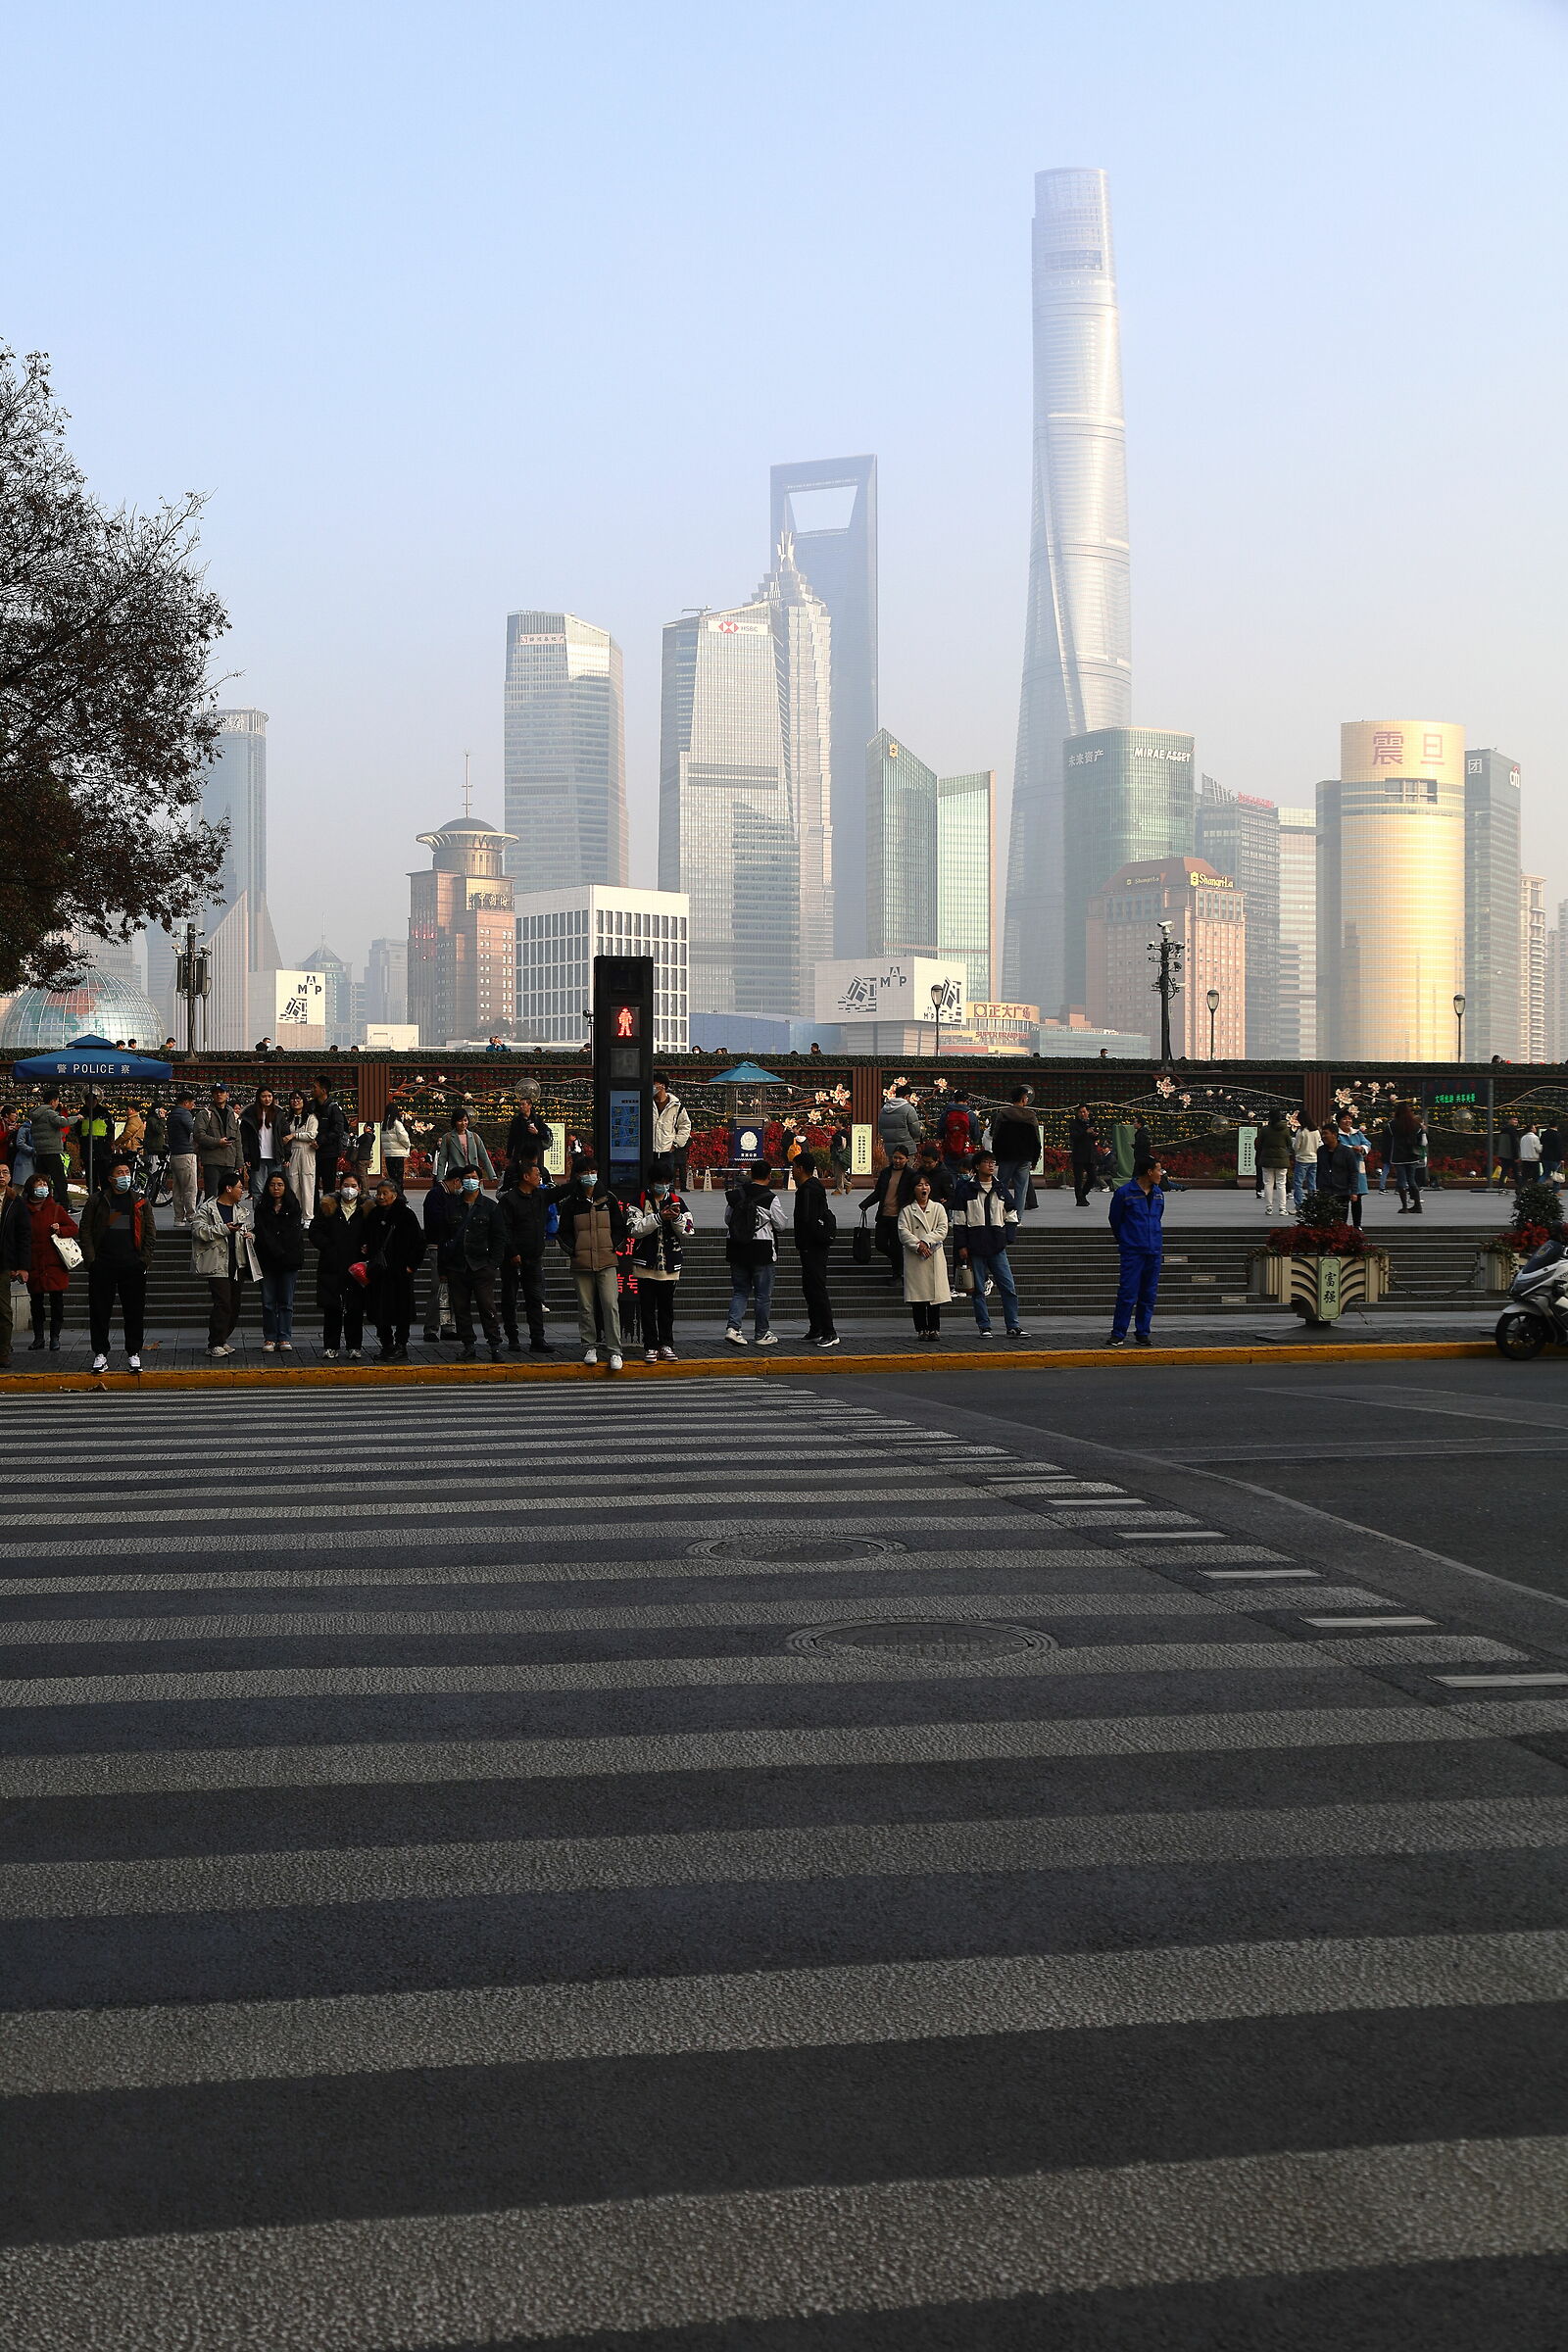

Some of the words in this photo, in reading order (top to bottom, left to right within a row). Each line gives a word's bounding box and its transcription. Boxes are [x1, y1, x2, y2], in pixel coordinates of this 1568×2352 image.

[1134, 747, 1165, 760] MIRAE
[1165, 751, 1192, 762] ASSET
[1372, 731, 1446, 765] 震旦
[1068, 749, 1104, 766] 未来资产
[988, 1004, 1031, 1019] 正大广场
[73, 1063, 115, 1074] POLICE
[1323, 1271, 1338, 1303] 富强
